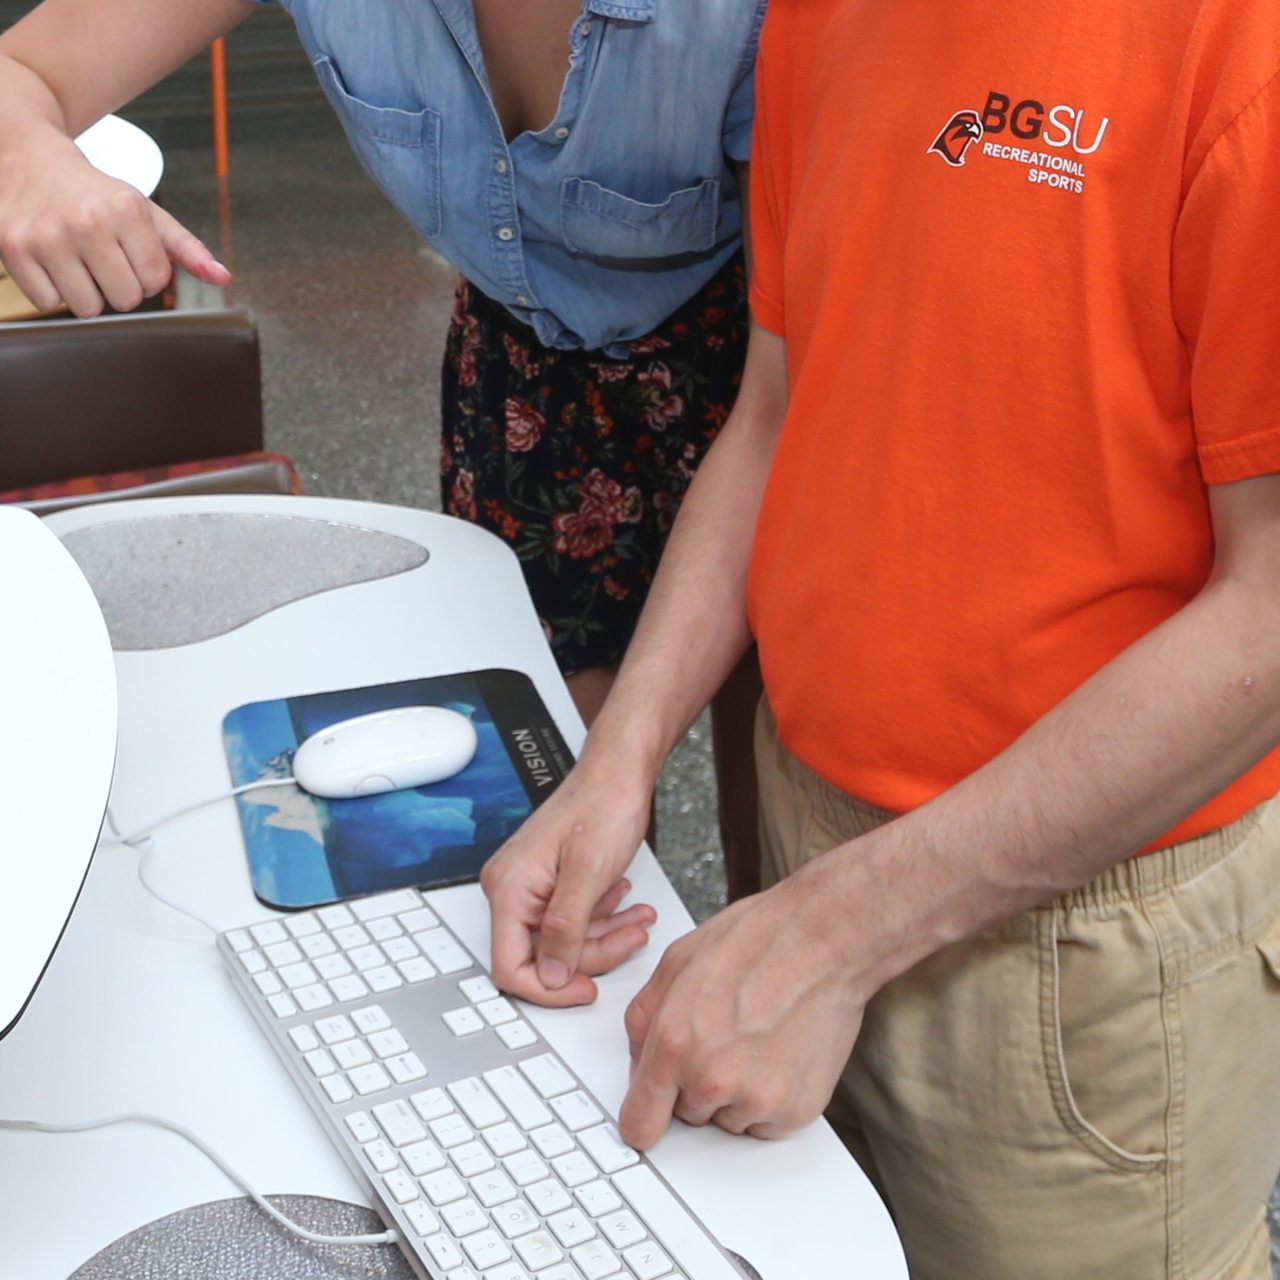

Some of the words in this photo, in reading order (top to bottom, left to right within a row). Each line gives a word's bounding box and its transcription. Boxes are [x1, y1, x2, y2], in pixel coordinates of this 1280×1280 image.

[981, 91, 1109, 155] BGSU
[982, 142, 1086, 177] RECREATIONAL
[1027, 169, 1084, 194] SPORTS
[511, 728, 554, 787] VISION
